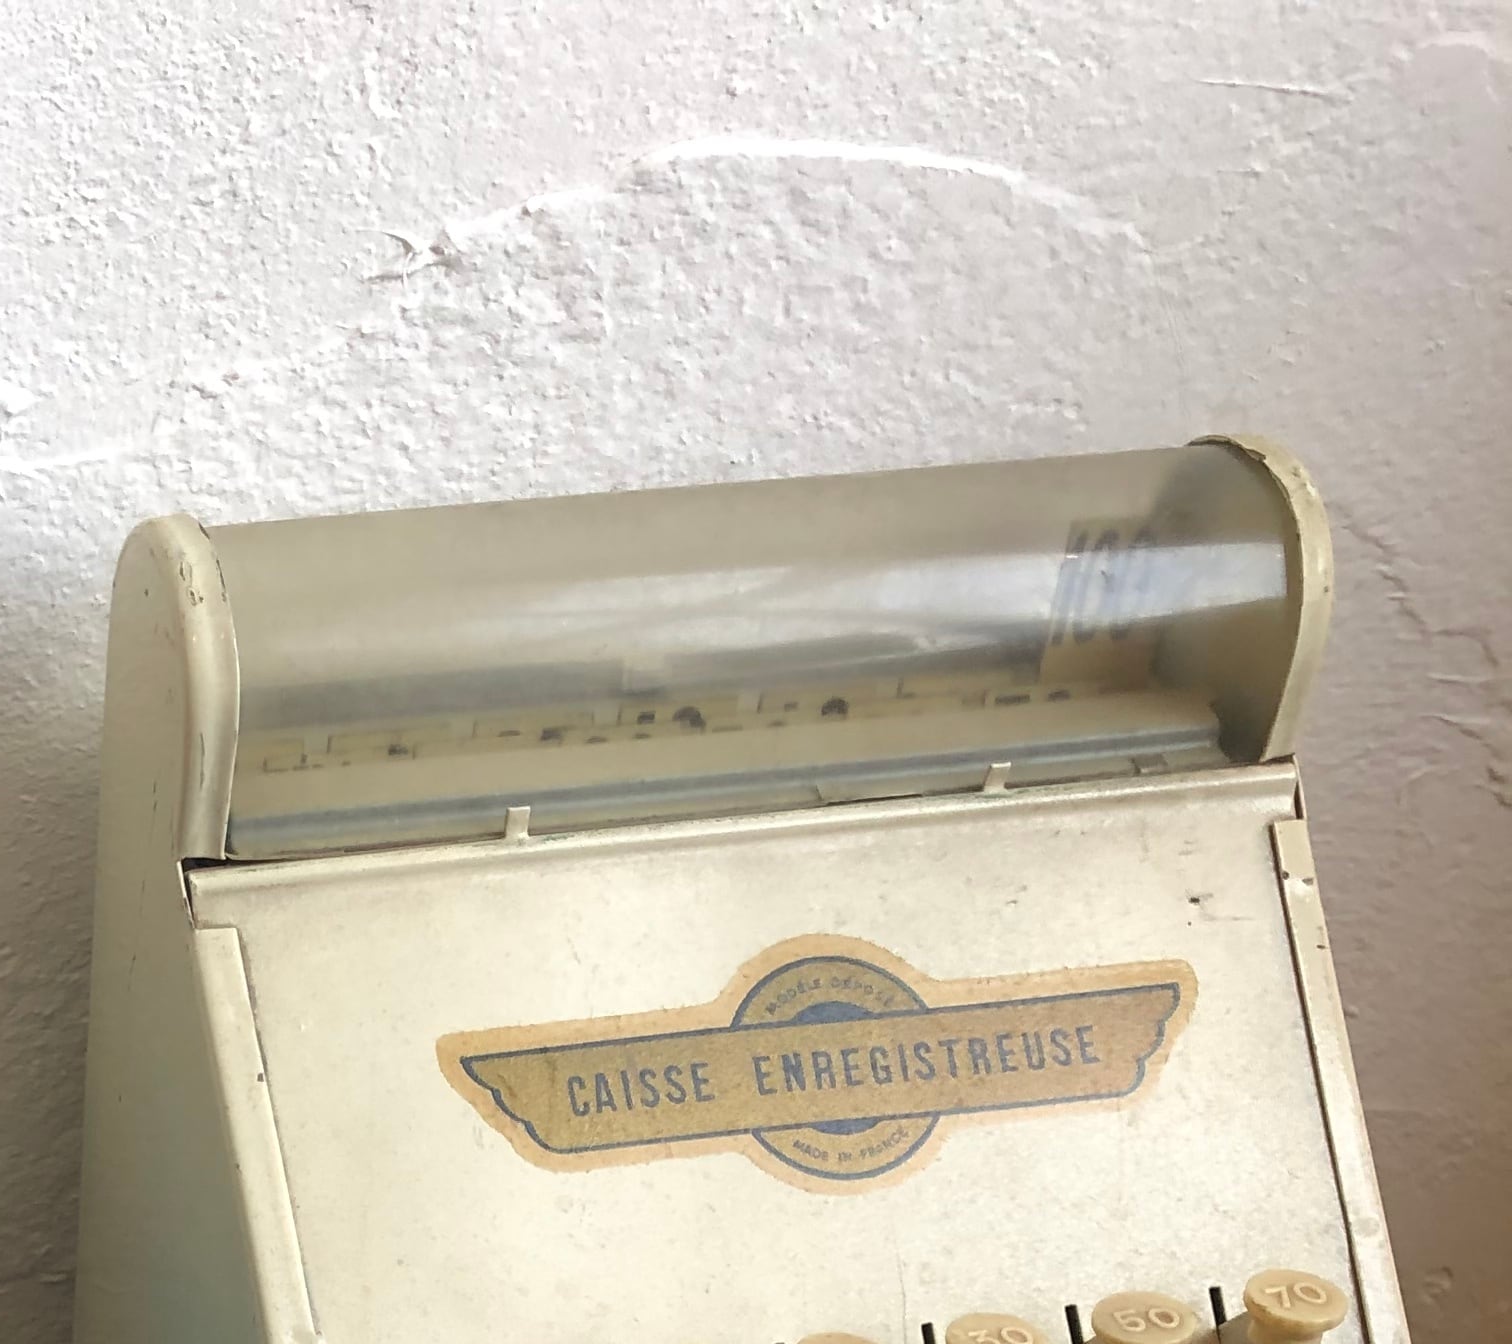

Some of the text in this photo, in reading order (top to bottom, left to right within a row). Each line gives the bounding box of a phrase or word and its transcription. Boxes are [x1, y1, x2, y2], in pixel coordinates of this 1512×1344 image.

[567, 1025, 1101, 1117] CAISSE ENREGISTREUSE
[792, 1125, 909, 1161] MADE IN FRANCE
[1113, 1307, 1181, 1333] 50
[1263, 1281, 1328, 1309] 70
